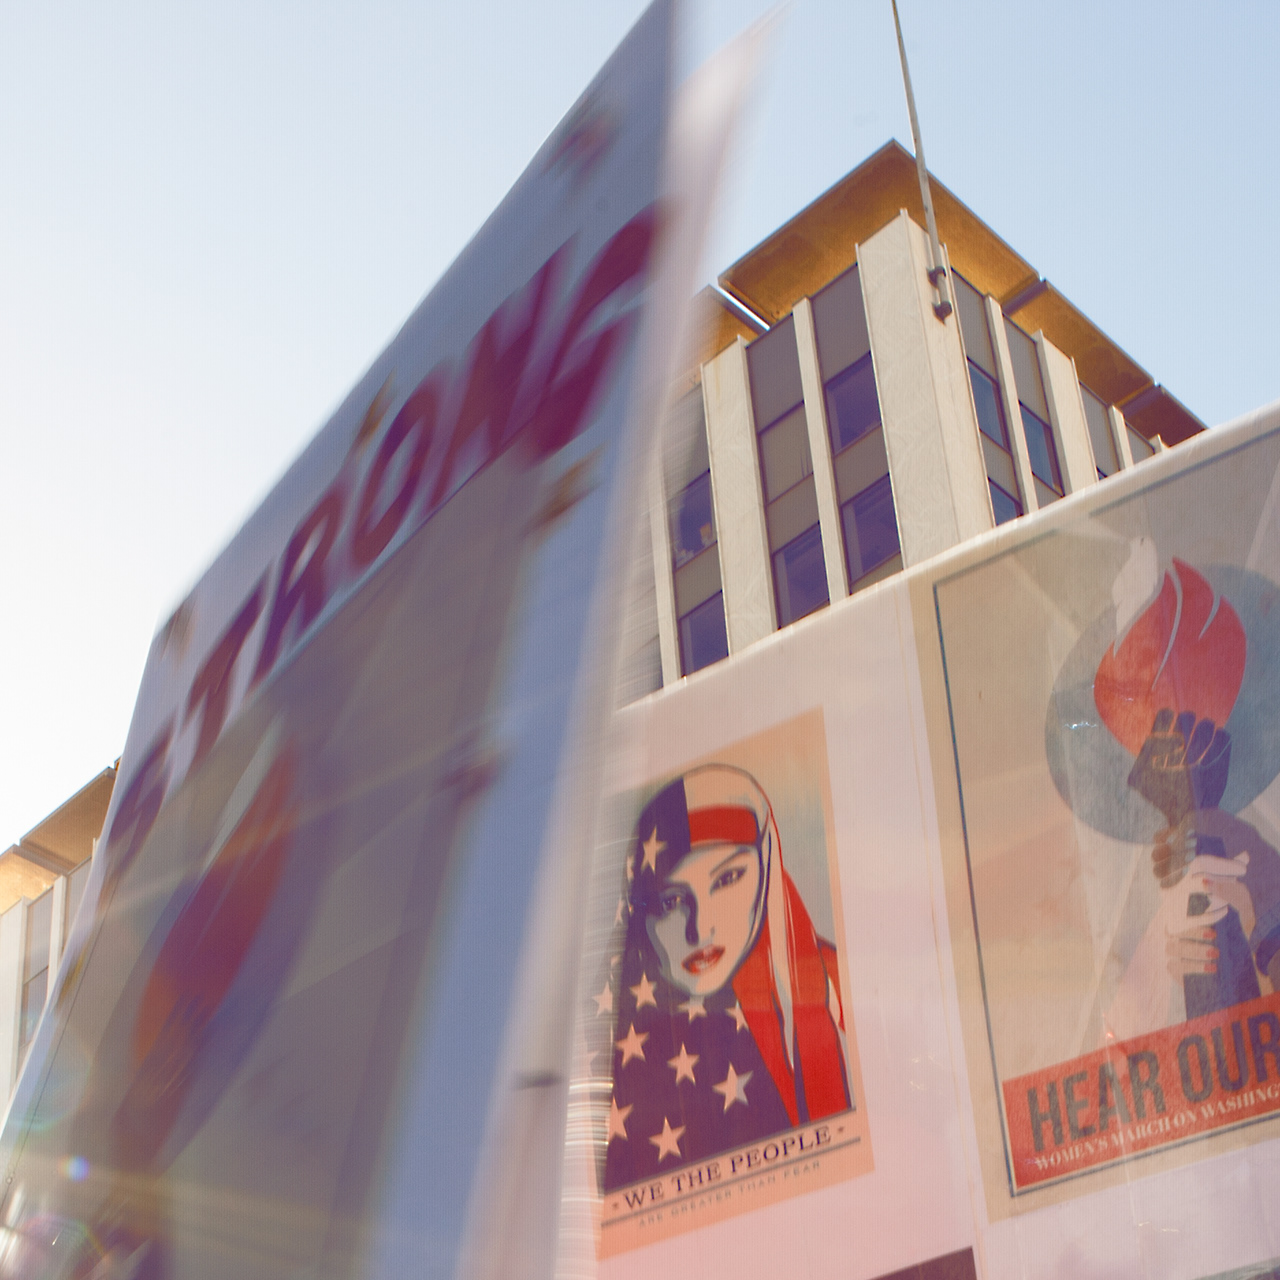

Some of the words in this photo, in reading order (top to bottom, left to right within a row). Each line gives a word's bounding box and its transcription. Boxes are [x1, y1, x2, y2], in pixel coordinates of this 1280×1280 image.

[1026, 1045, 1167, 1152] HEAR
[622, 1181, 665, 1210] WE
[671, 1161, 722, 1192] THE
[729, 1124, 831, 1173] PEOPLE
[1033, 1133, 1109, 1171] WOMEN'S
[1111, 1118, 1171, 1151] MARCH
[1171, 1112, 1198, 1130] ON
[638, 1213, 664, 1228] ARE
[671, 1188, 733, 1217] GREATER
[739, 1175, 776, 1193] THAN
[783, 1160, 821, 1180] FEAR
